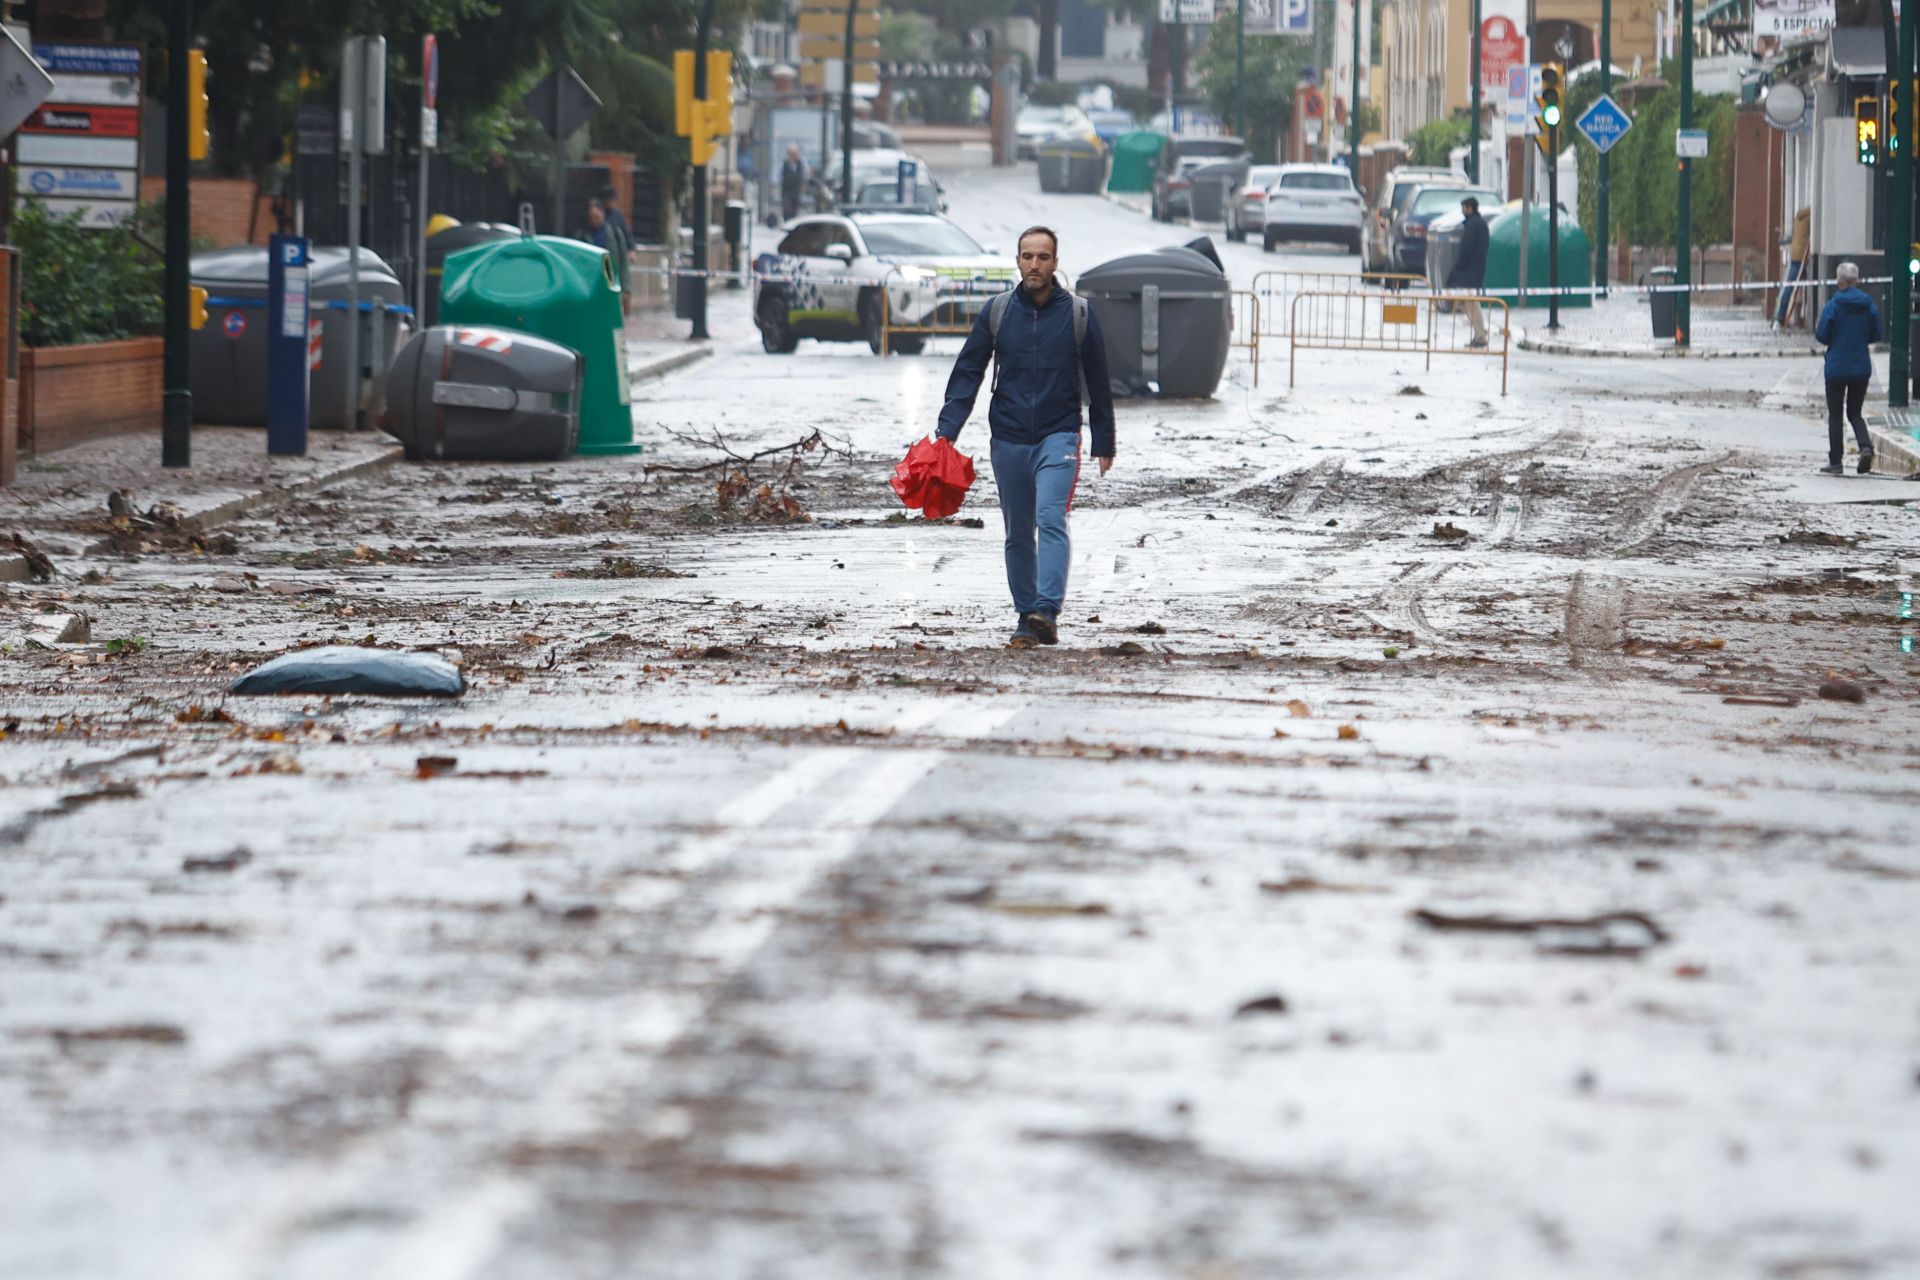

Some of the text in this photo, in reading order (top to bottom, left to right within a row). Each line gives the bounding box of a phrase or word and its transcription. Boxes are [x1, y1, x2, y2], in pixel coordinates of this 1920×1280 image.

[1283, 0, 1306, 28] P
[1594, 114, 1614, 124] RED
[283, 243, 300, 264] P
